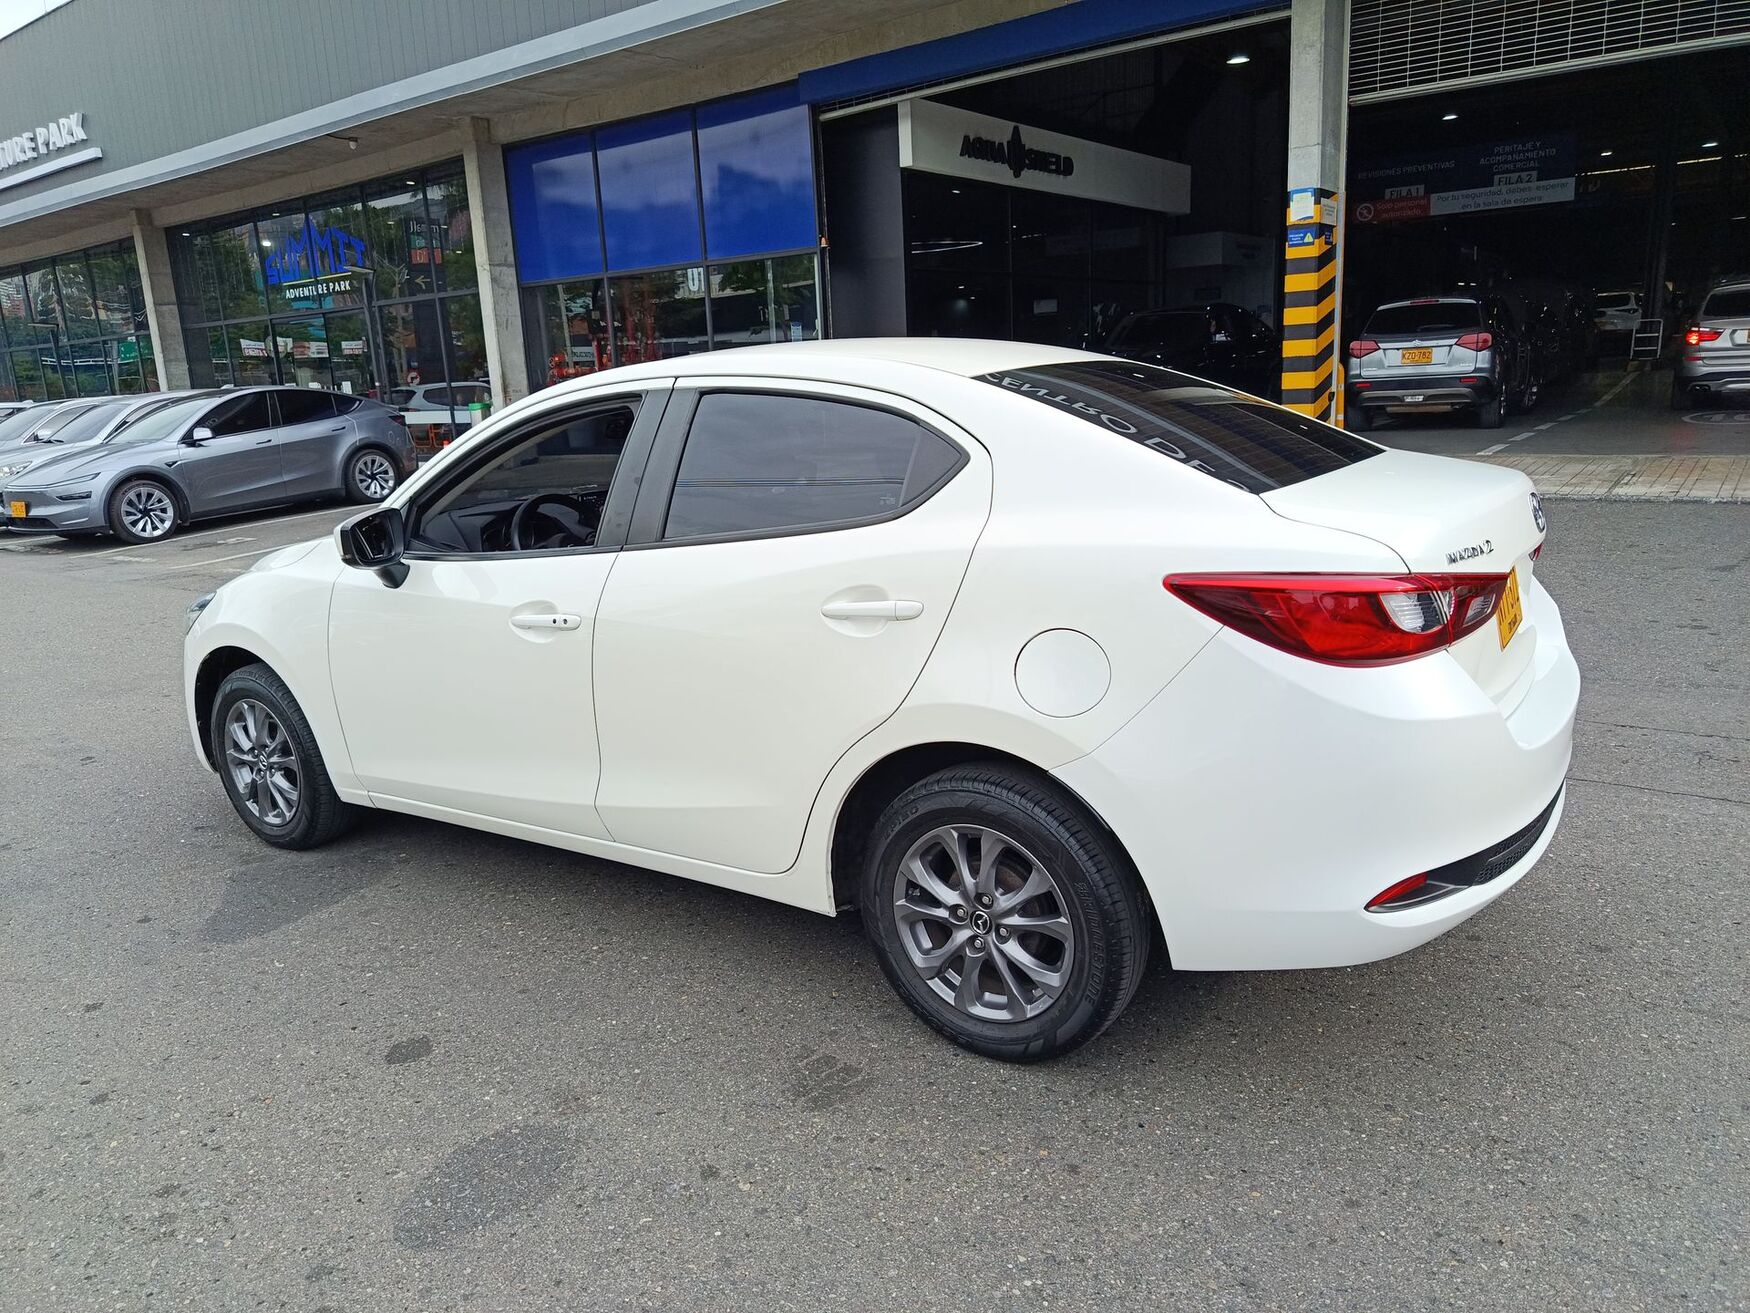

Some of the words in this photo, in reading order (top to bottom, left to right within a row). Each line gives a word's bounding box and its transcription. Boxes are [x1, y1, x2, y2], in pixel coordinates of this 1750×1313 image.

[0, 132, 37, 170] TURE
[35, 112, 88, 154] PARK
[960, 135, 1008, 165] AQUA
[1494, 142, 1535, 154] PERITAJE
[1492, 160, 1539, 172] COMERCIAL
[1498, 175, 1523, 186] FILA
[1524, 173, 1533, 183] 2
[1390, 188, 1413, 198] FILA
[1535, 182, 1569, 192] esperar
[265, 216, 367, 286] SUMMIT
[329, 280, 351, 293] PARK
[1445, 545, 1485, 565] MAZDA
[1484, 540, 1494, 554] 2
